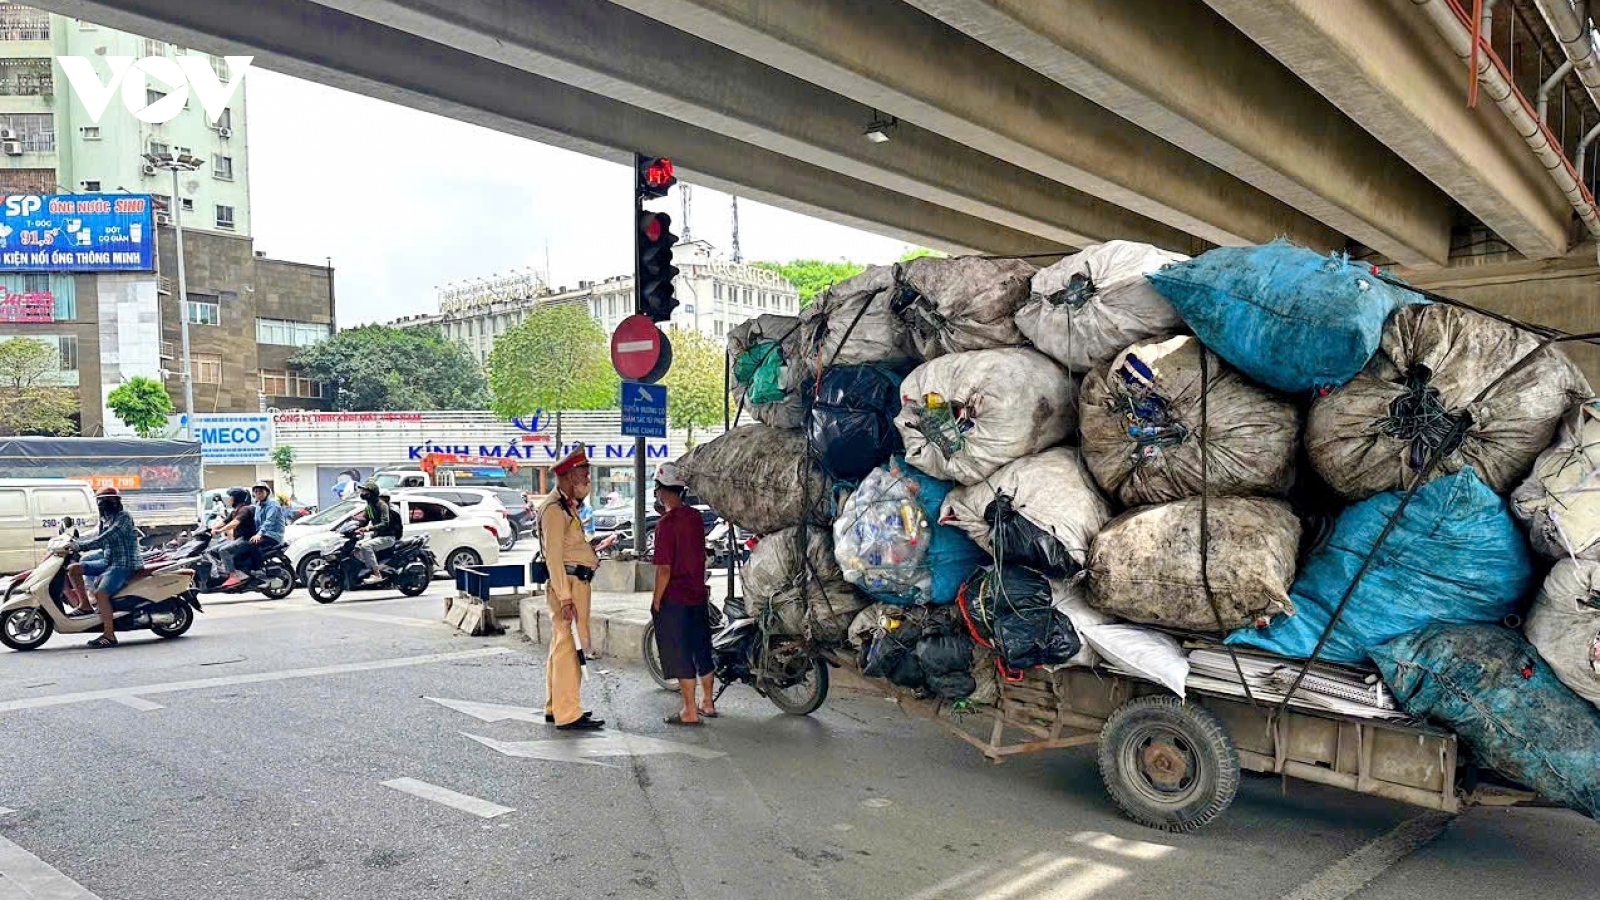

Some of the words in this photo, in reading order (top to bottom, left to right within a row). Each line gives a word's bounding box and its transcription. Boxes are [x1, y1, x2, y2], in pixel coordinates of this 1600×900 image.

[115, 199, 145, 213] SINO
[3, 251, 28, 266] KIỆN
[31, 250, 49, 264] NỐI
[51, 250, 74, 264] ỐNG
[75, 250, 110, 264] THÔNG
[112, 252, 140, 264] MINH
[408, 439, 469, 459] KÍNH
[479, 439, 534, 458] MẮT
